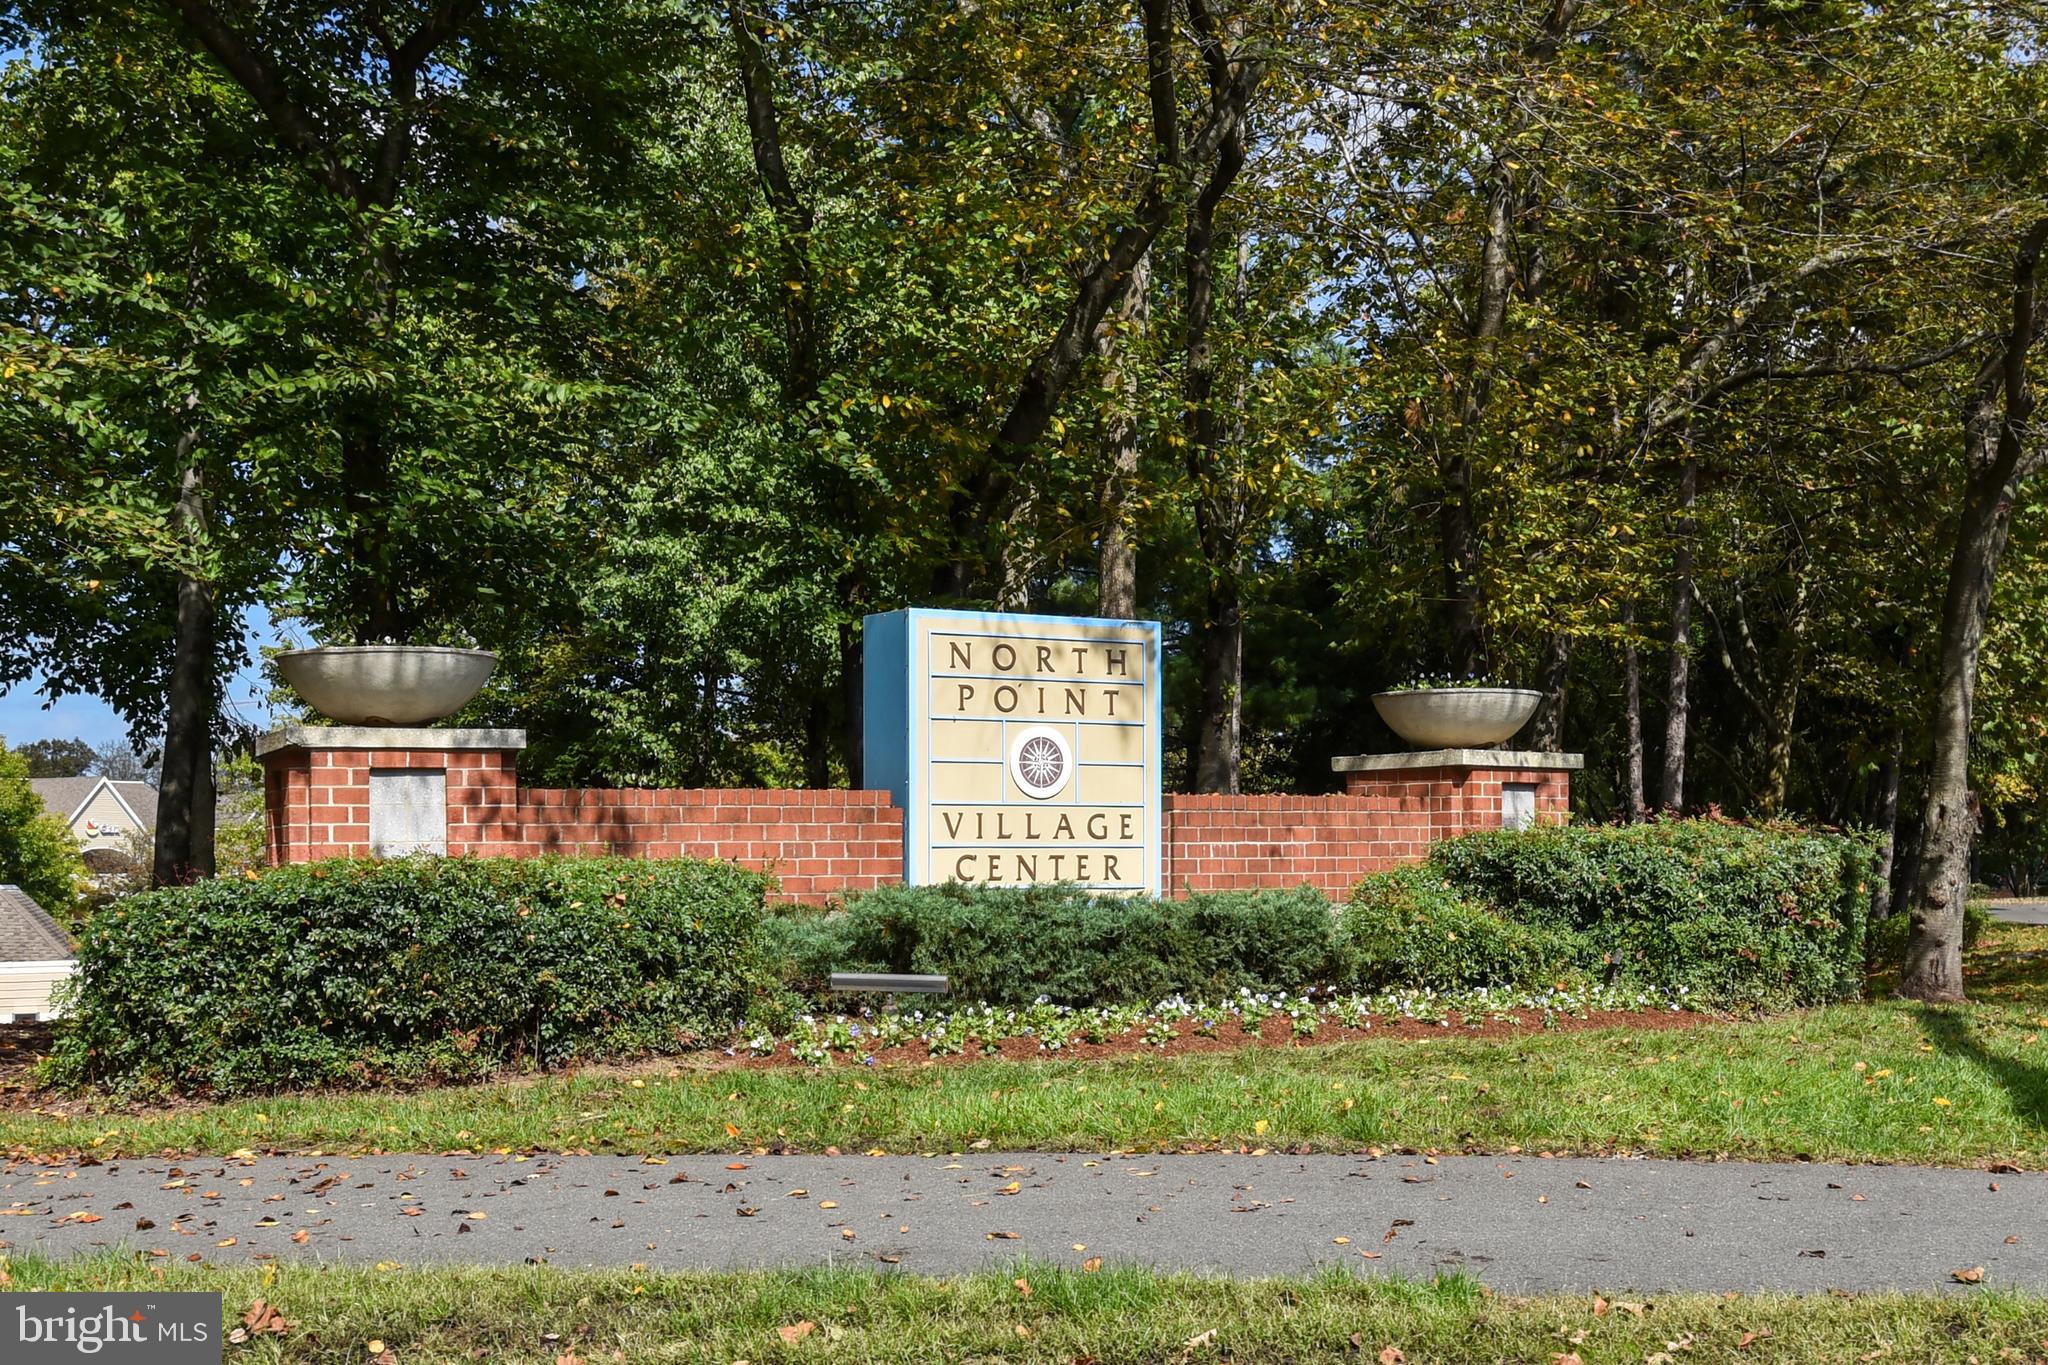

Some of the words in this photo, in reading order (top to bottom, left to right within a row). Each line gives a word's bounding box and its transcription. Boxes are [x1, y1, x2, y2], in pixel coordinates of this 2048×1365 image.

[949, 641, 1127, 676] NORTH
[957, 683, 1120, 716] POINT
[942, 812, 1134, 840] VILLAGE
[955, 854, 1122, 882] CENTER
